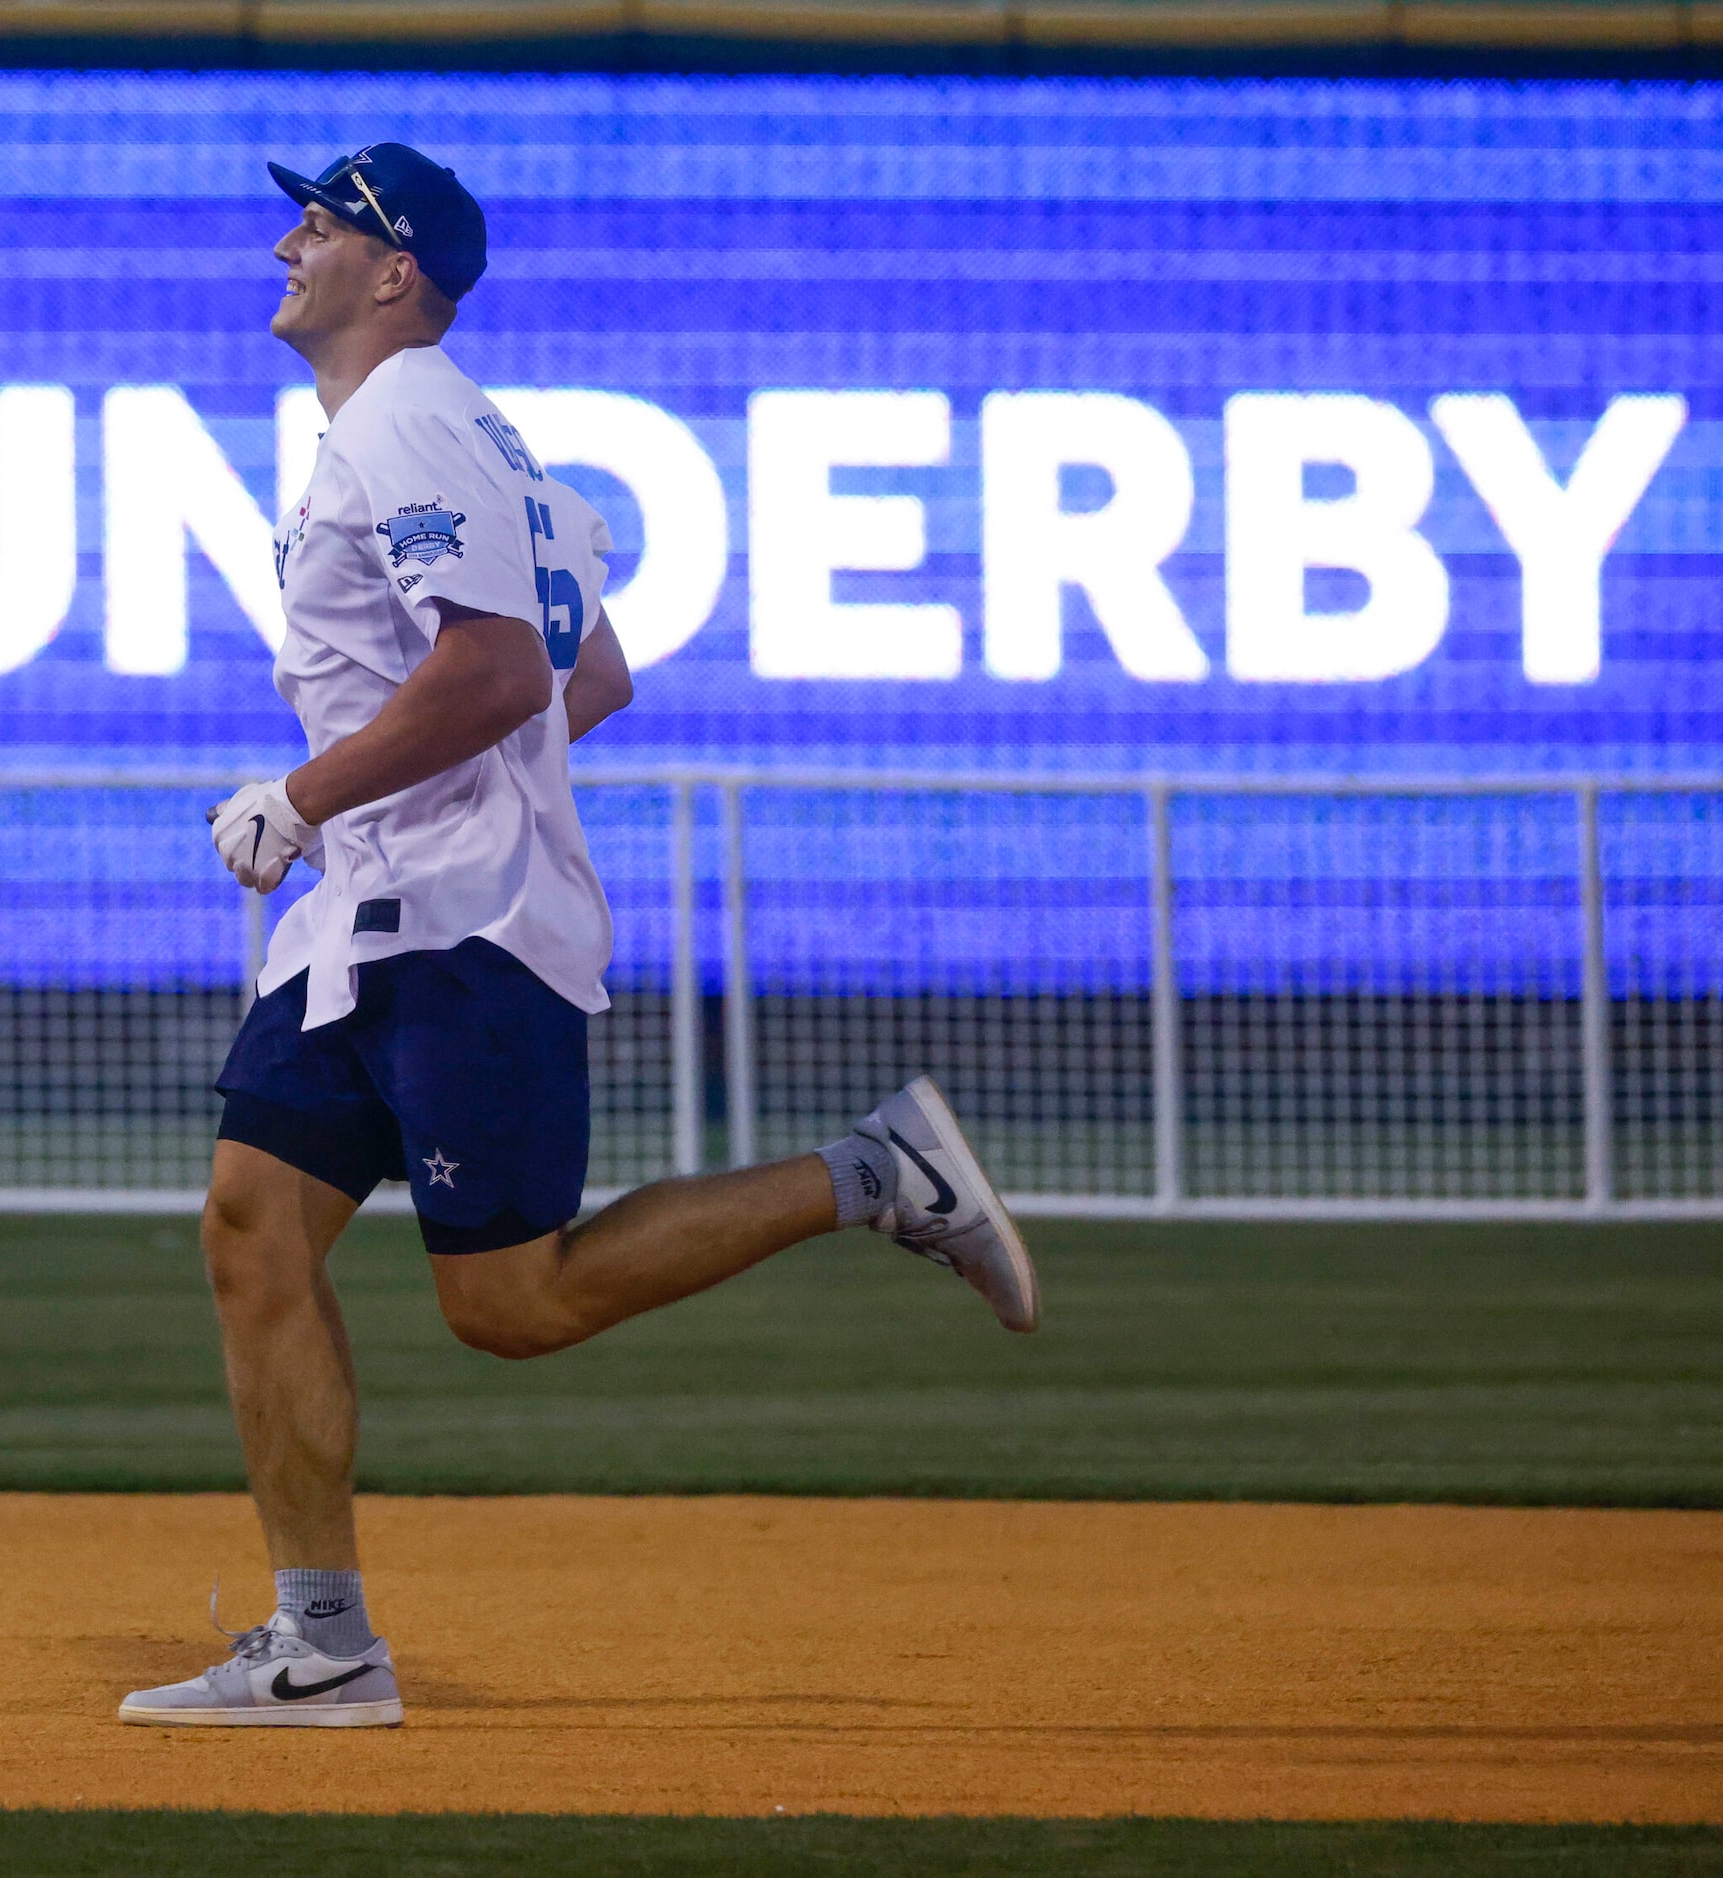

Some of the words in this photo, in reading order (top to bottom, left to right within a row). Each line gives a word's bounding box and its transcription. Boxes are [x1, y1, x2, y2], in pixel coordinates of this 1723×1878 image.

[398, 532, 427, 549] HOME
[428, 532, 450, 542] RUN
[484, 388, 1687, 686] DERBY
[310, 1598, 346, 1610] NIKE
